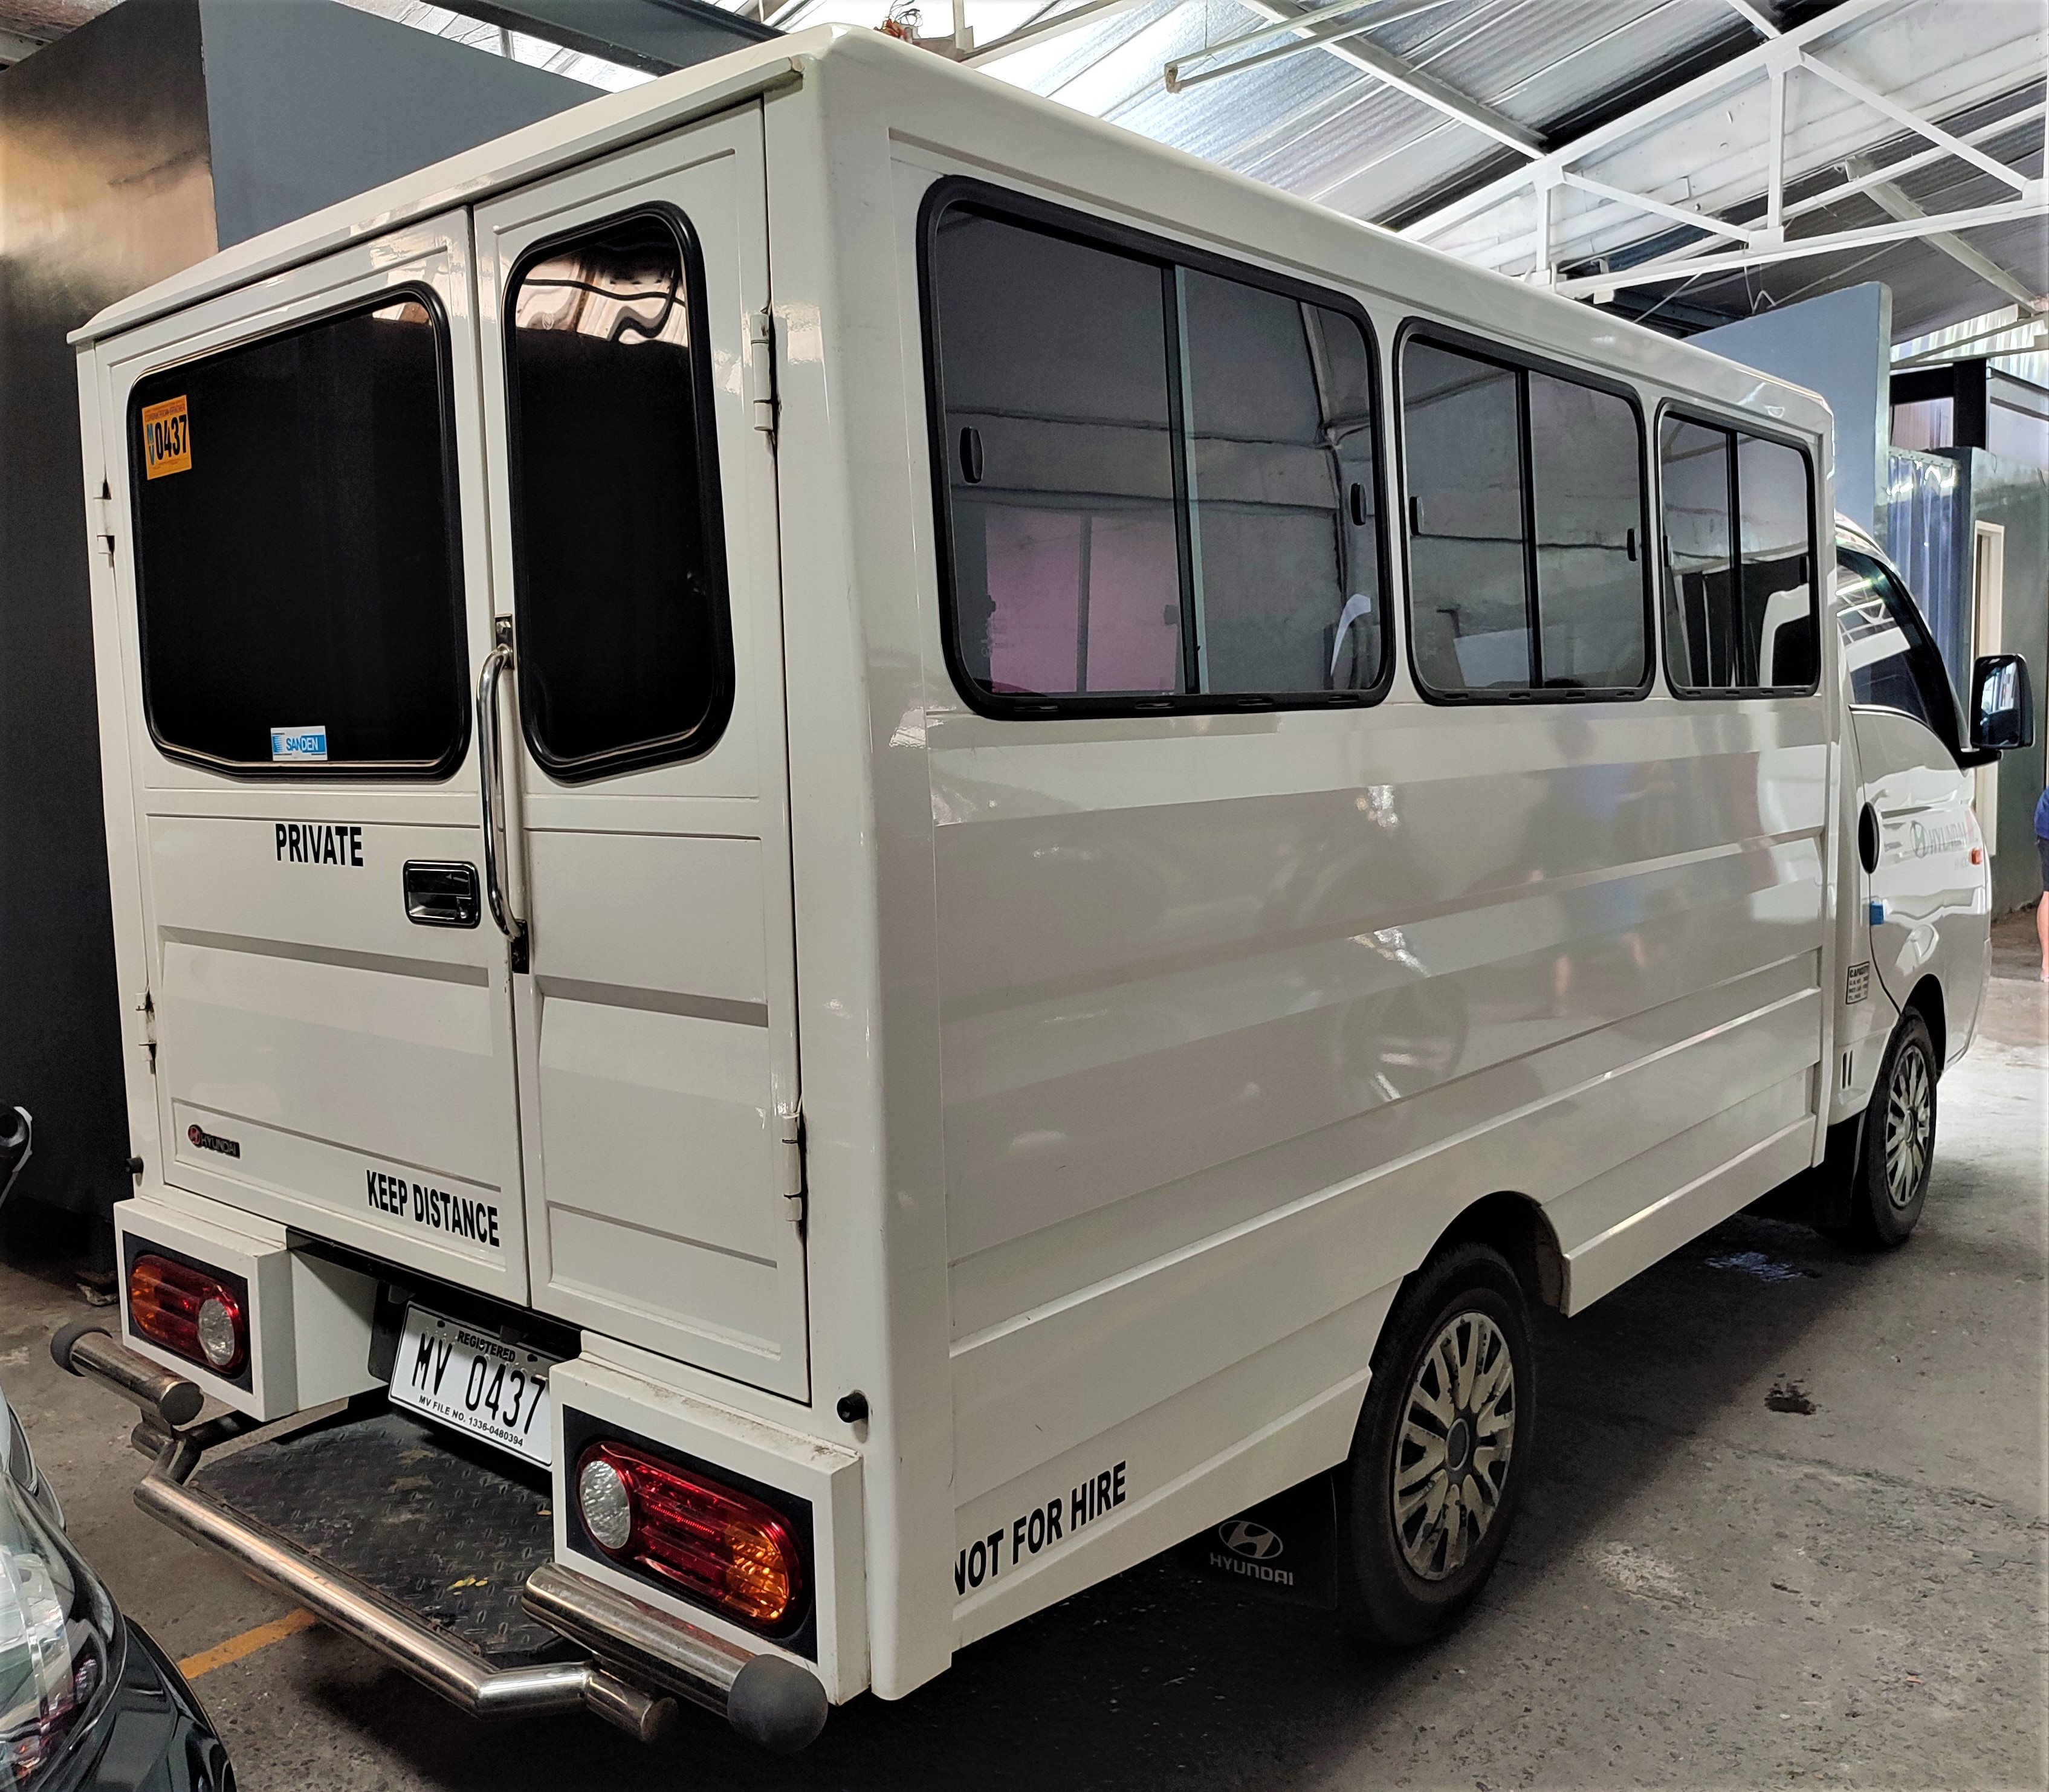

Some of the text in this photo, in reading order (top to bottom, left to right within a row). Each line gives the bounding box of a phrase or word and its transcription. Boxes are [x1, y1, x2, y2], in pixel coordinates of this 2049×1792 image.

[155, 414, 187, 461] 0437
[286, 737, 319, 751] SANDEN
[275, 823, 364, 867] PRIVATE
[201, 1134, 236, 1156] HYUNDAI
[366, 1169, 500, 1247] KEEP DISTANCE
[457, 1330, 516, 1362] REGISTERED
[412, 1333, 546, 1435] MV 0437
[419, 1395, 523, 1447] MV FILE NO. 1336-0480394
[1012, 1498, 1063, 1565] FOR
[1071, 1460, 1125, 1532] HIRE
[1209, 1552, 1294, 1586] HYUNDAI
